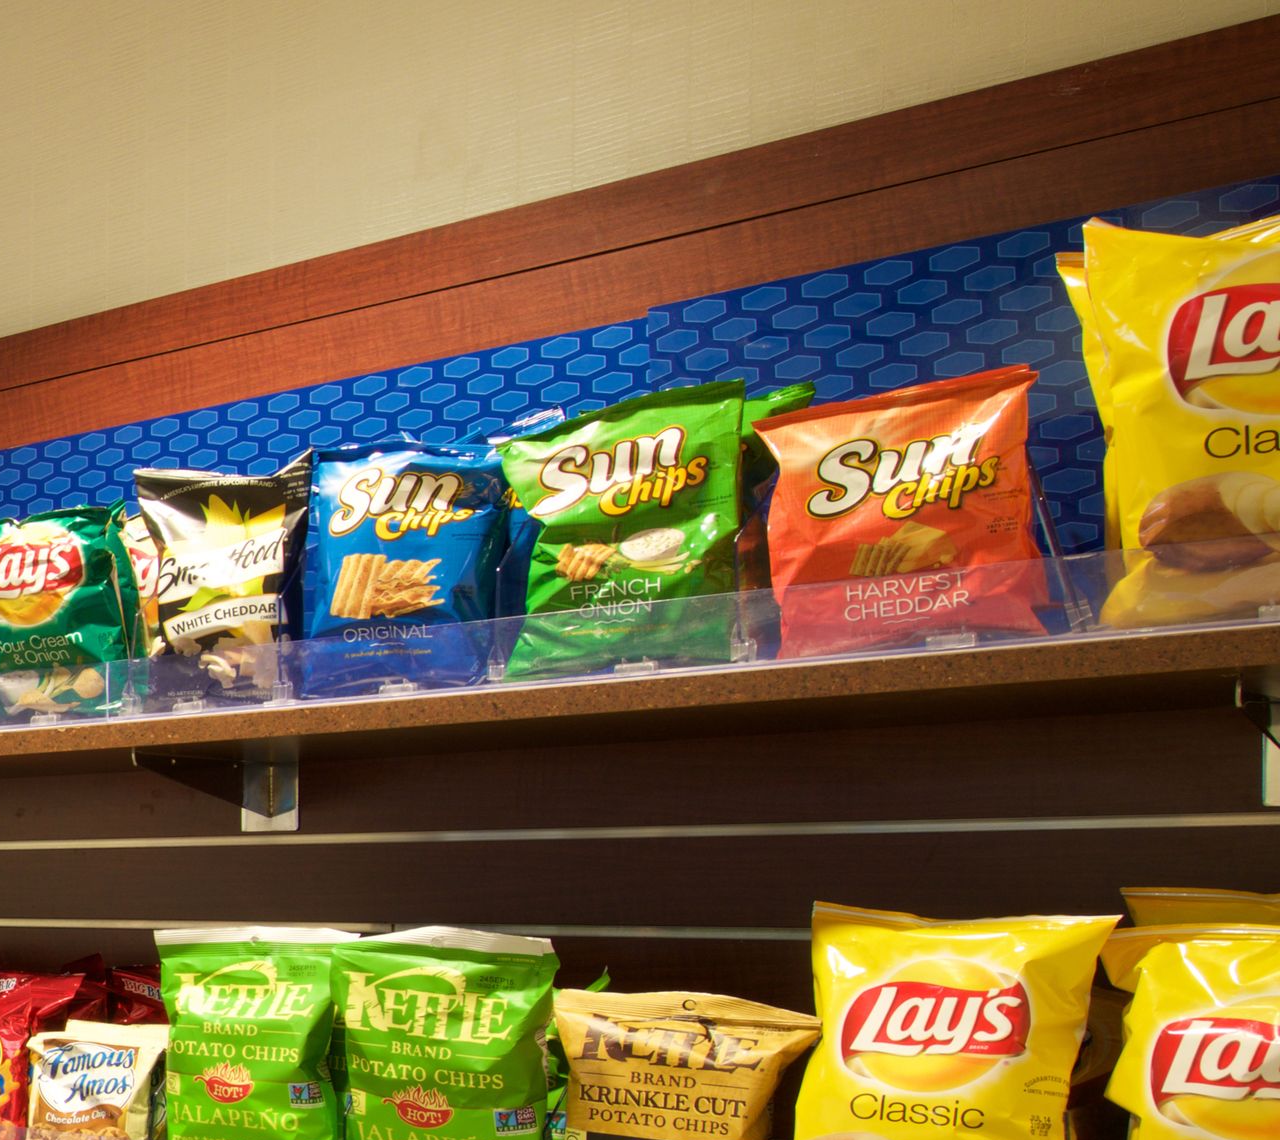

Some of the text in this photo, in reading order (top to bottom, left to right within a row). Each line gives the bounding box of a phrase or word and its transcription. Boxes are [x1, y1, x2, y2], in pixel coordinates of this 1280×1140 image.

[531, 424, 688, 521] Sun
[601, 452, 708, 518] Chips
[806, 429, 984, 521] Sun
[329, 466, 464, 539] Sun
[881, 458, 998, 521] Chips
[374, 504, 471, 542] Chips
[569, 576, 661, 601] FRENCH
[844, 571, 968, 600] HARVEST
[172, 602, 276, 637] WHITE CHEDDAR
[578, 596, 652, 619] ONION
[844, 589, 970, 622] CHEDDAR
[29, 630, 83, 650] Cream
[343, 625, 432, 642] ORIGINAL
[14, 648, 69, 665] & Onion
[343, 966, 513, 1045] KETTLE
[203, 1022, 258, 1037] BRAND
[850, 986, 1023, 1056] Lay's
[42, 1043, 136, 1080] Famous
[168, 1040, 299, 1063] POTATO CHIPS
[391, 1040, 452, 1060] BRAND
[351, 1055, 504, 1090] POTATO CHIPS
[630, 1071, 697, 1089] BRAND
[65, 1074, 133, 1104] Amos
[213, 1085, 244, 1099] HOT!
[579, 1084, 690, 1113] KRINKLE
[173, 1101, 299, 1132] JALAPEÑO
[405, 1106, 444, 1125] HOT!
[589, 1107, 729, 1135] POTATO CHIPS
[849, 1092, 986, 1131] Classic
